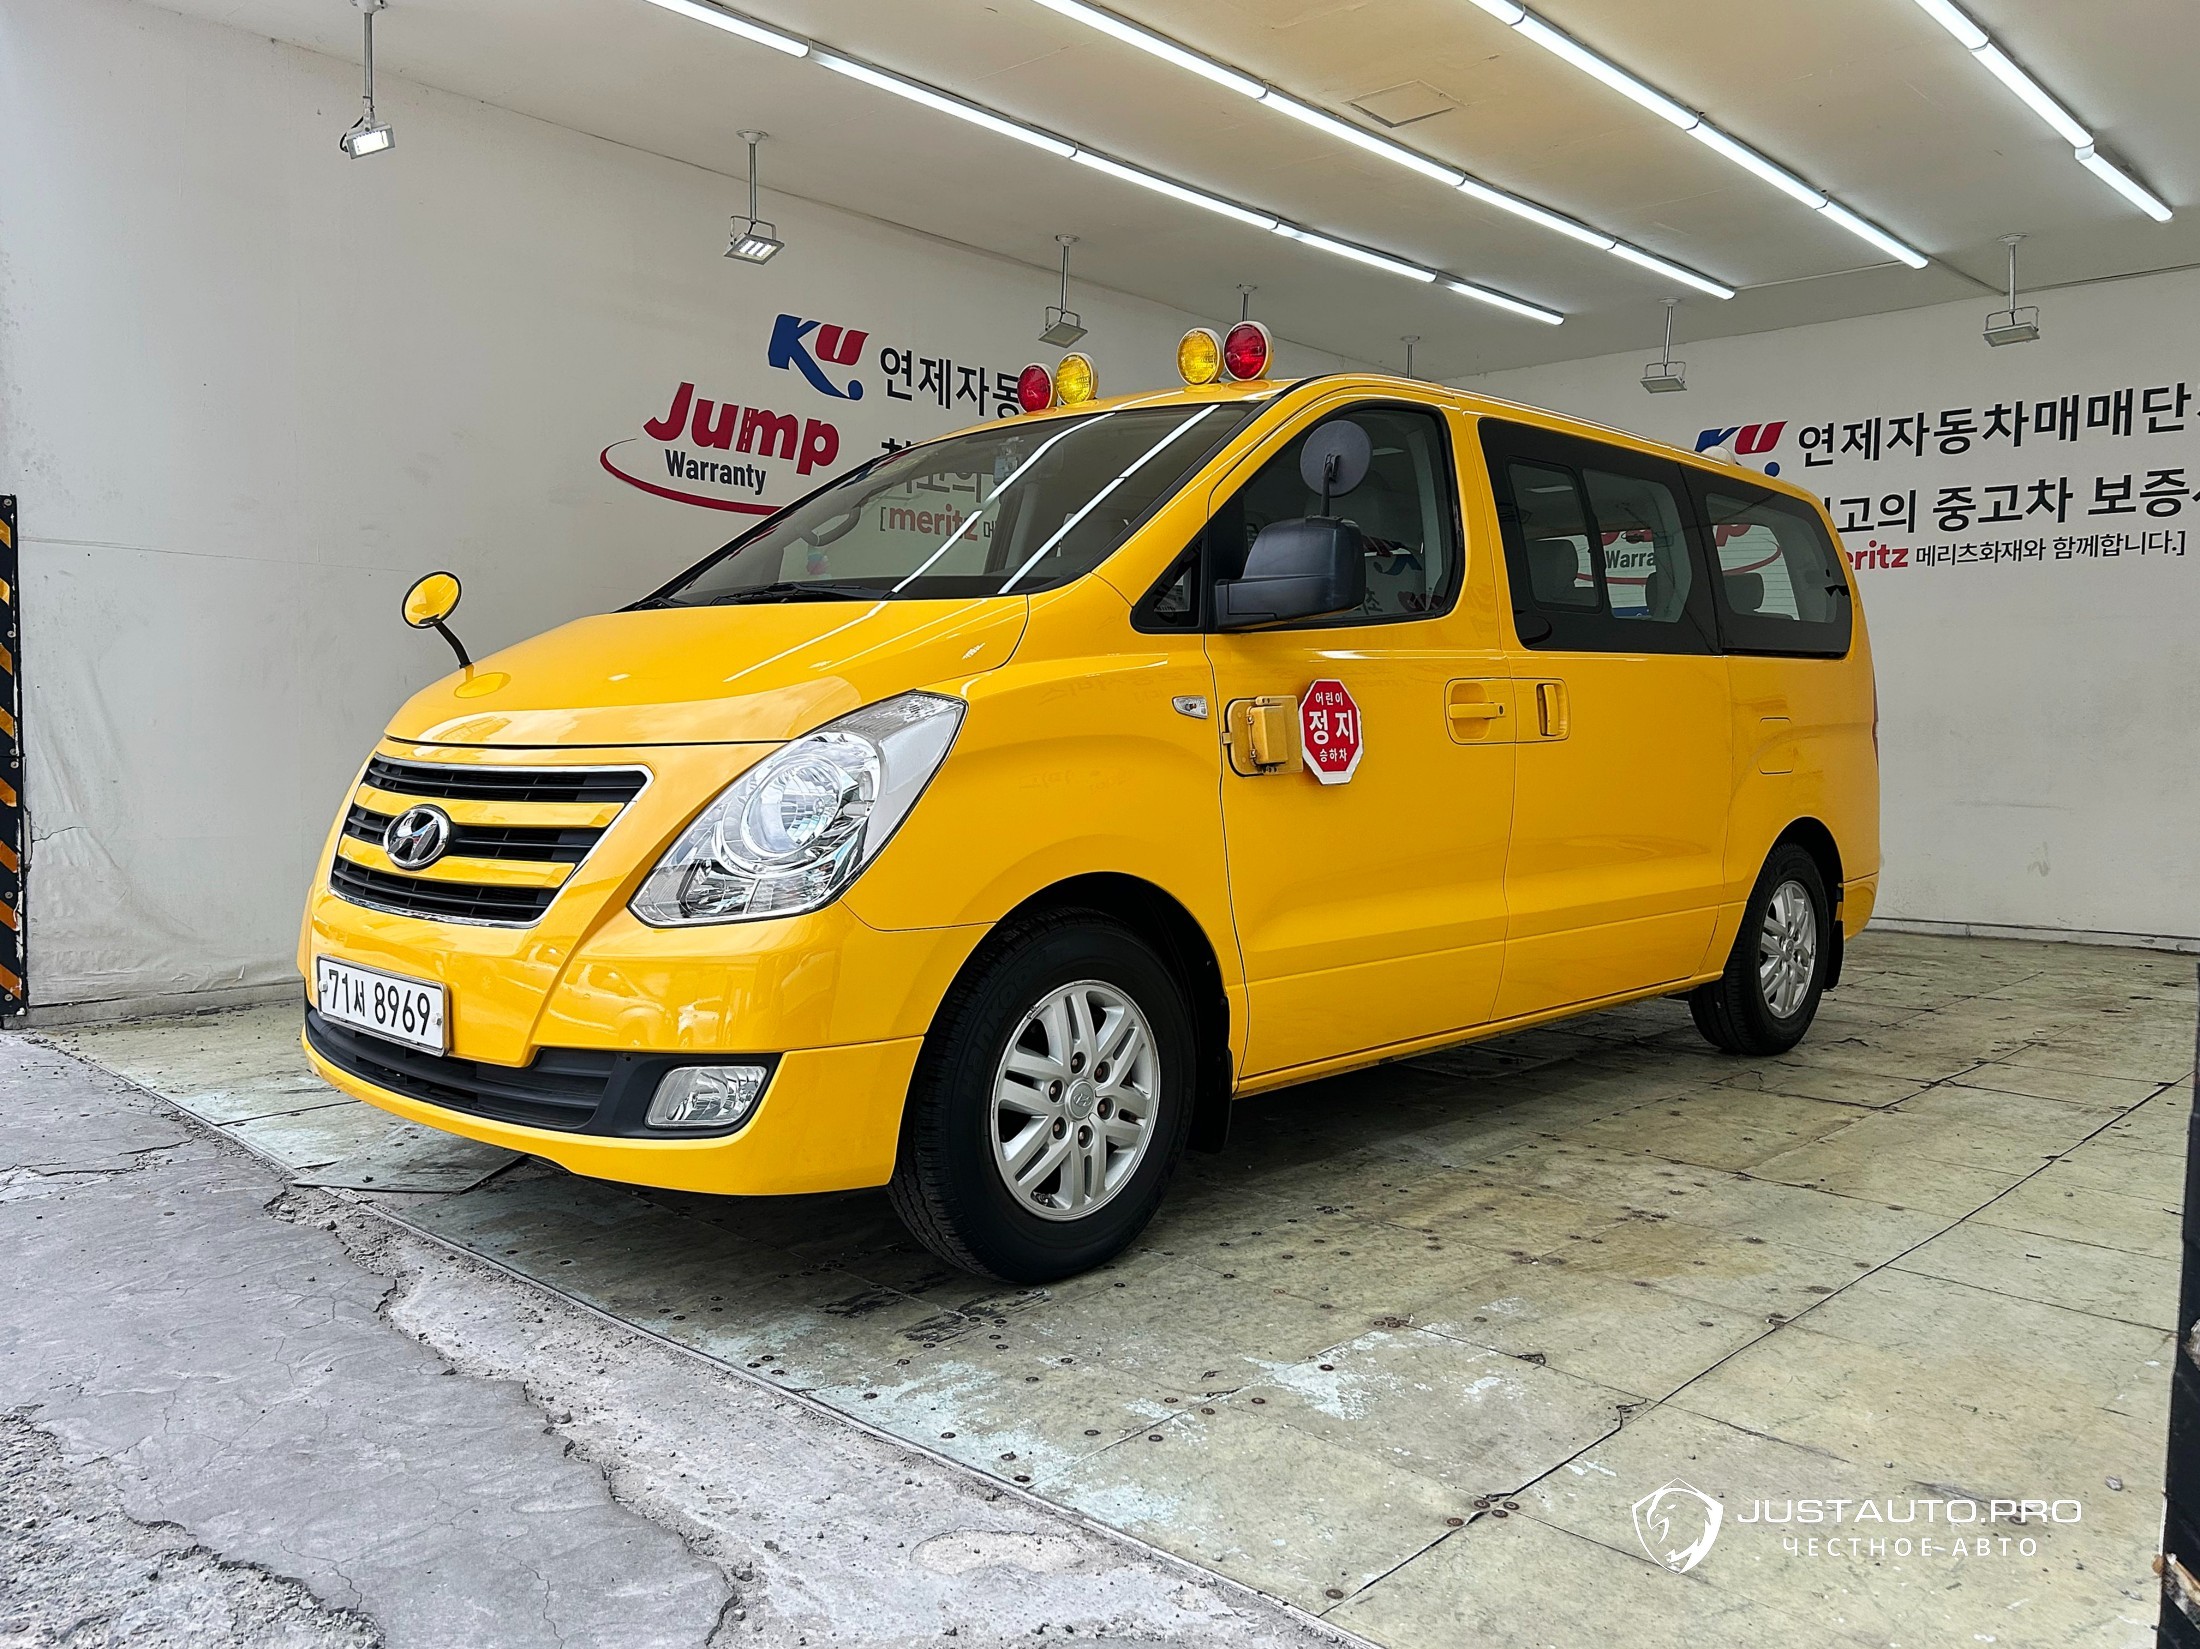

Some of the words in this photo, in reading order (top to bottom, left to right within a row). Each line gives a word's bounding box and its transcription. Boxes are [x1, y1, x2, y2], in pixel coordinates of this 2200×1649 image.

[643, 382, 840, 476] Jump
[1798, 382, 2200, 468] 연제자동차매매단
[665, 448, 767, 495] Warranty
[1824, 489, 1916, 533] 고의
[1931, 476, 2073, 533] 중고차
[2087, 468, 2200, 518] 보증
[1916, 537, 2046, 568] 메리츠화재와
[2052, 529, 2186, 560] 함께합니다.]
[1315, 691, 1344, 706] 어린이
[1308, 709, 1355, 745] 정지
[1319, 748, 1348, 762] 승하차
[328, 968, 366, 1017] 71서
[374, 981, 431, 1036] 8969
